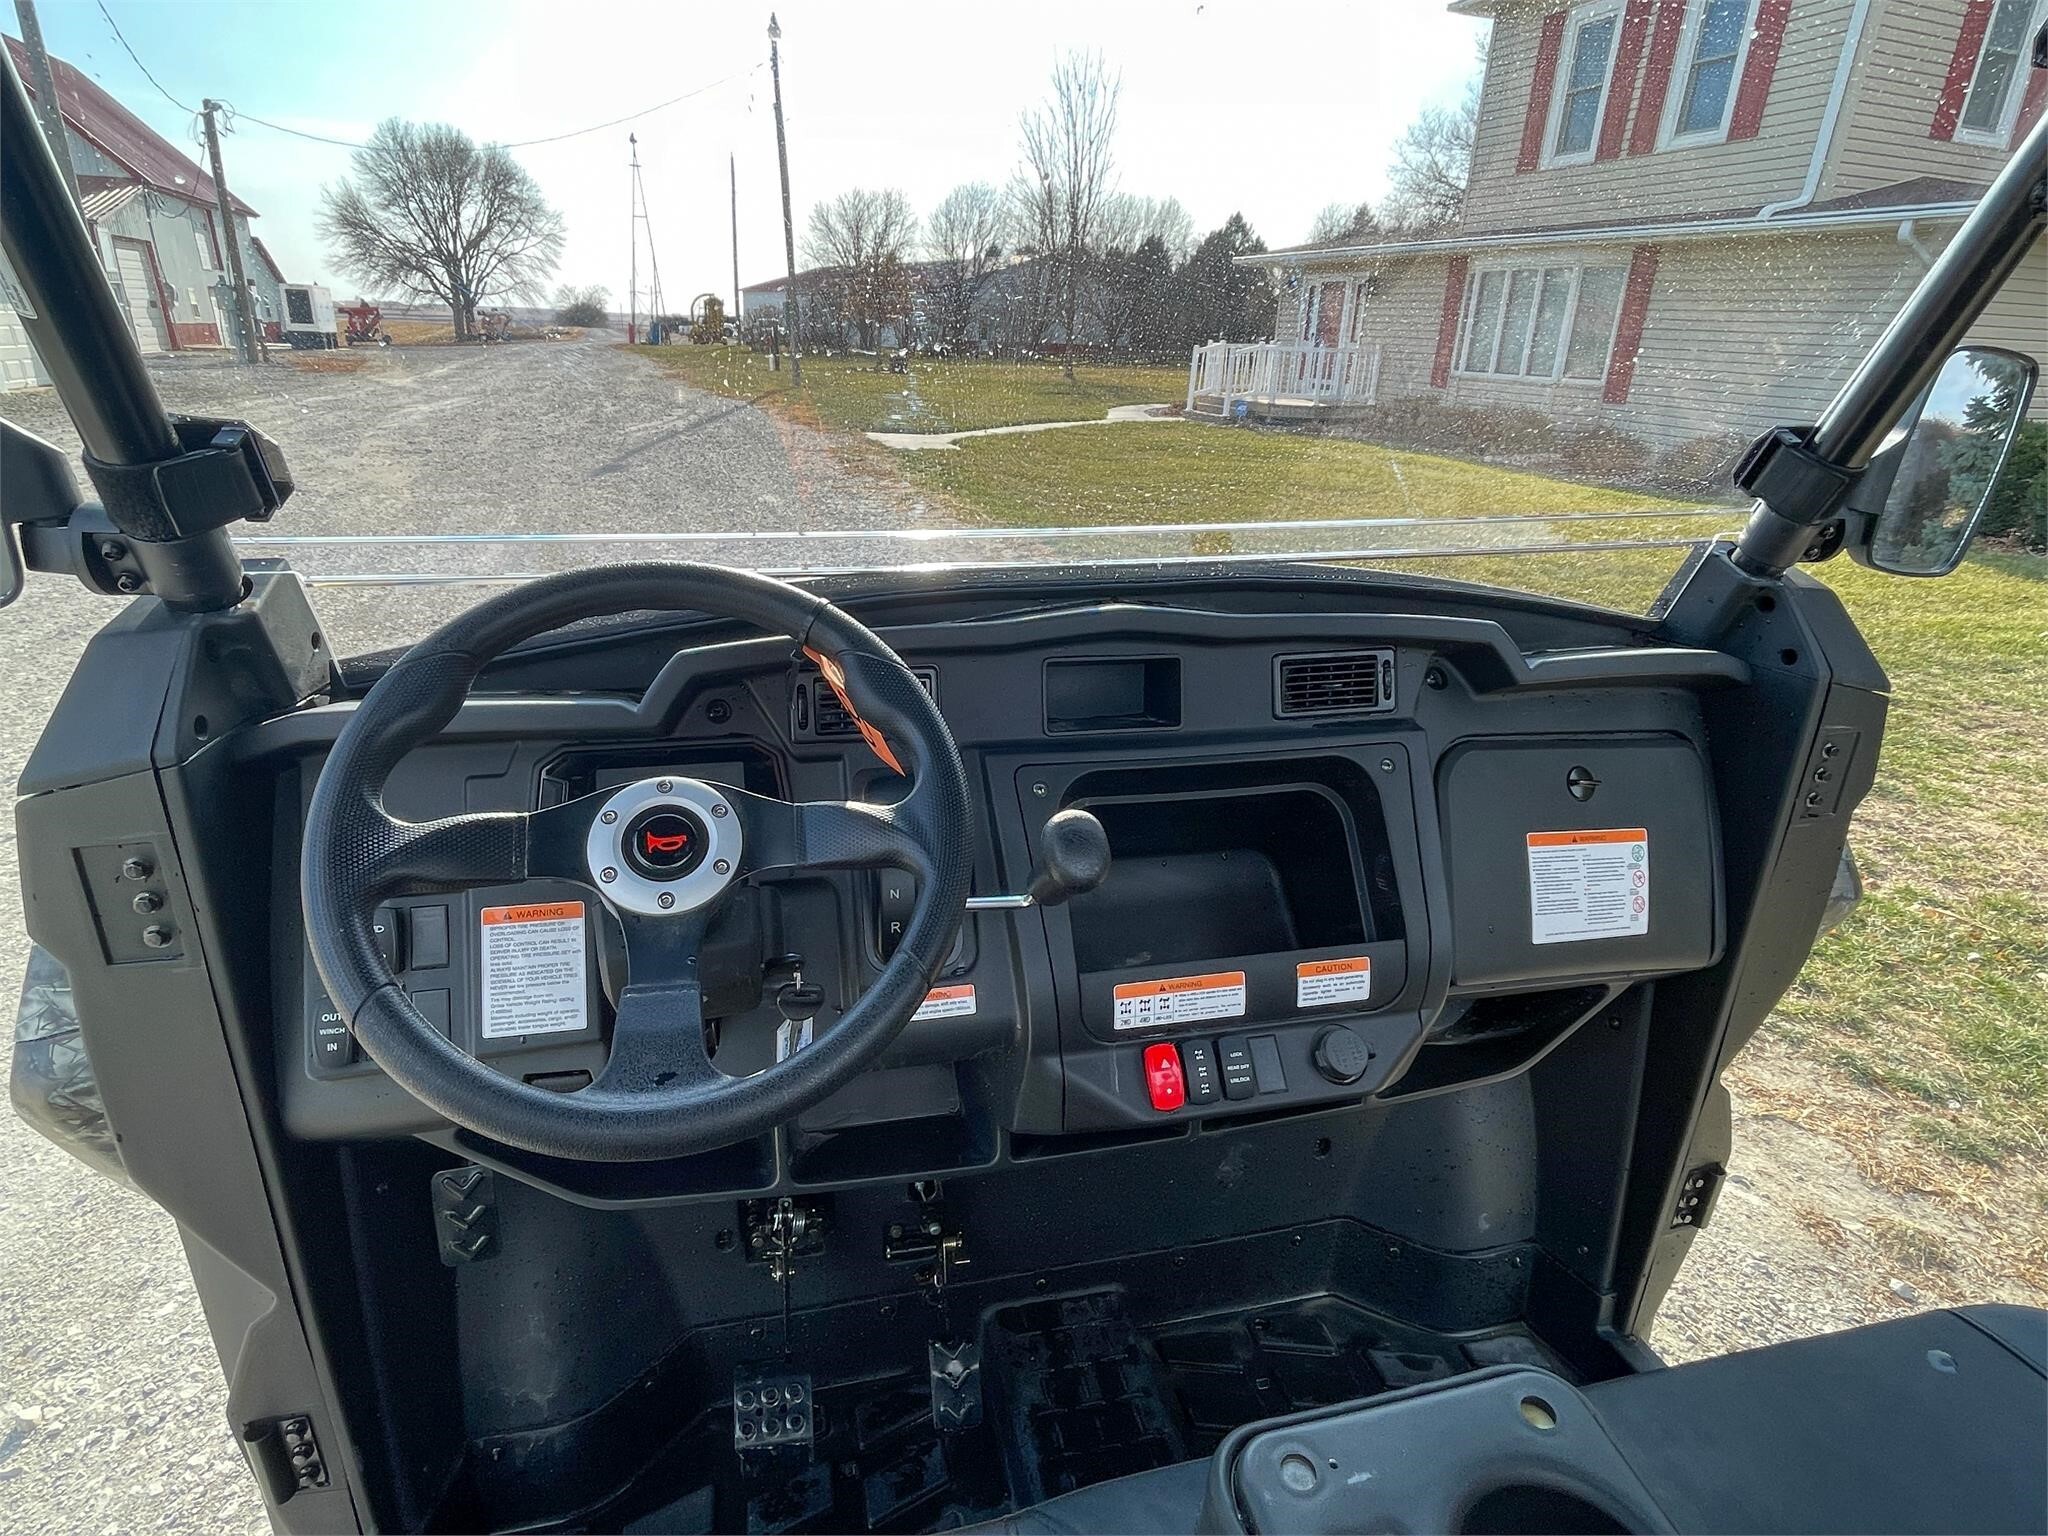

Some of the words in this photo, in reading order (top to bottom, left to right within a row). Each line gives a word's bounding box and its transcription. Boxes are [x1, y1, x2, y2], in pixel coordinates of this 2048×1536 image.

[890, 889, 900, 899] N
[516, 908, 564, 919] WARNING
[891, 921, 901, 933] R
[1316, 963, 1352, 973] CAUTION
[1167, 981, 1203, 990] WARNING
[327, 1043, 337, 1051] IN
